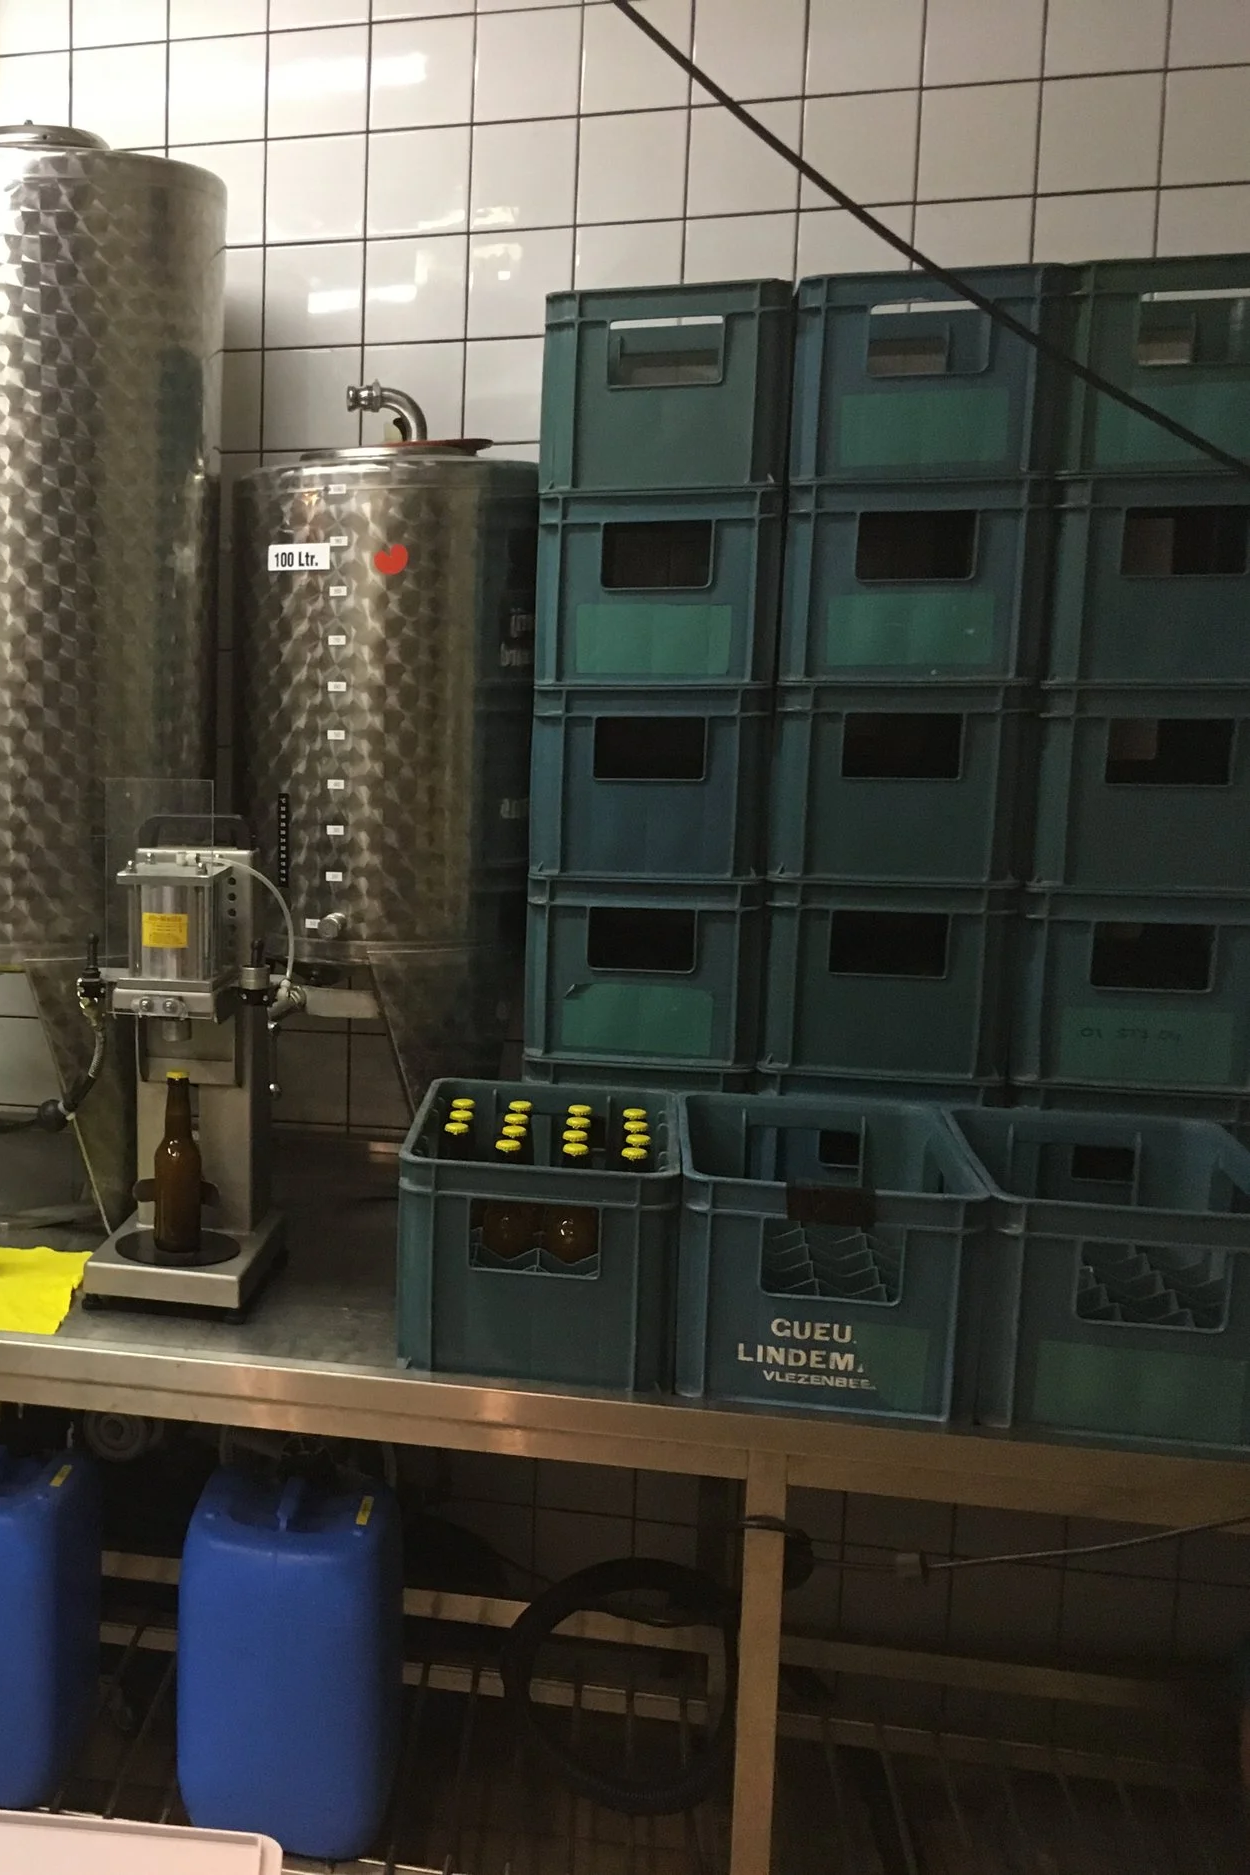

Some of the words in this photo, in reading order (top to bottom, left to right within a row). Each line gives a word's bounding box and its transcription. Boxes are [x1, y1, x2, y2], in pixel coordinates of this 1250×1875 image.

[274, 551, 295, 568] 100
[298, 550, 319, 567] Ltr.
[771, 1317, 857, 1344] GUEU
[763, 1369, 877, 1391] VLEZENBEE
